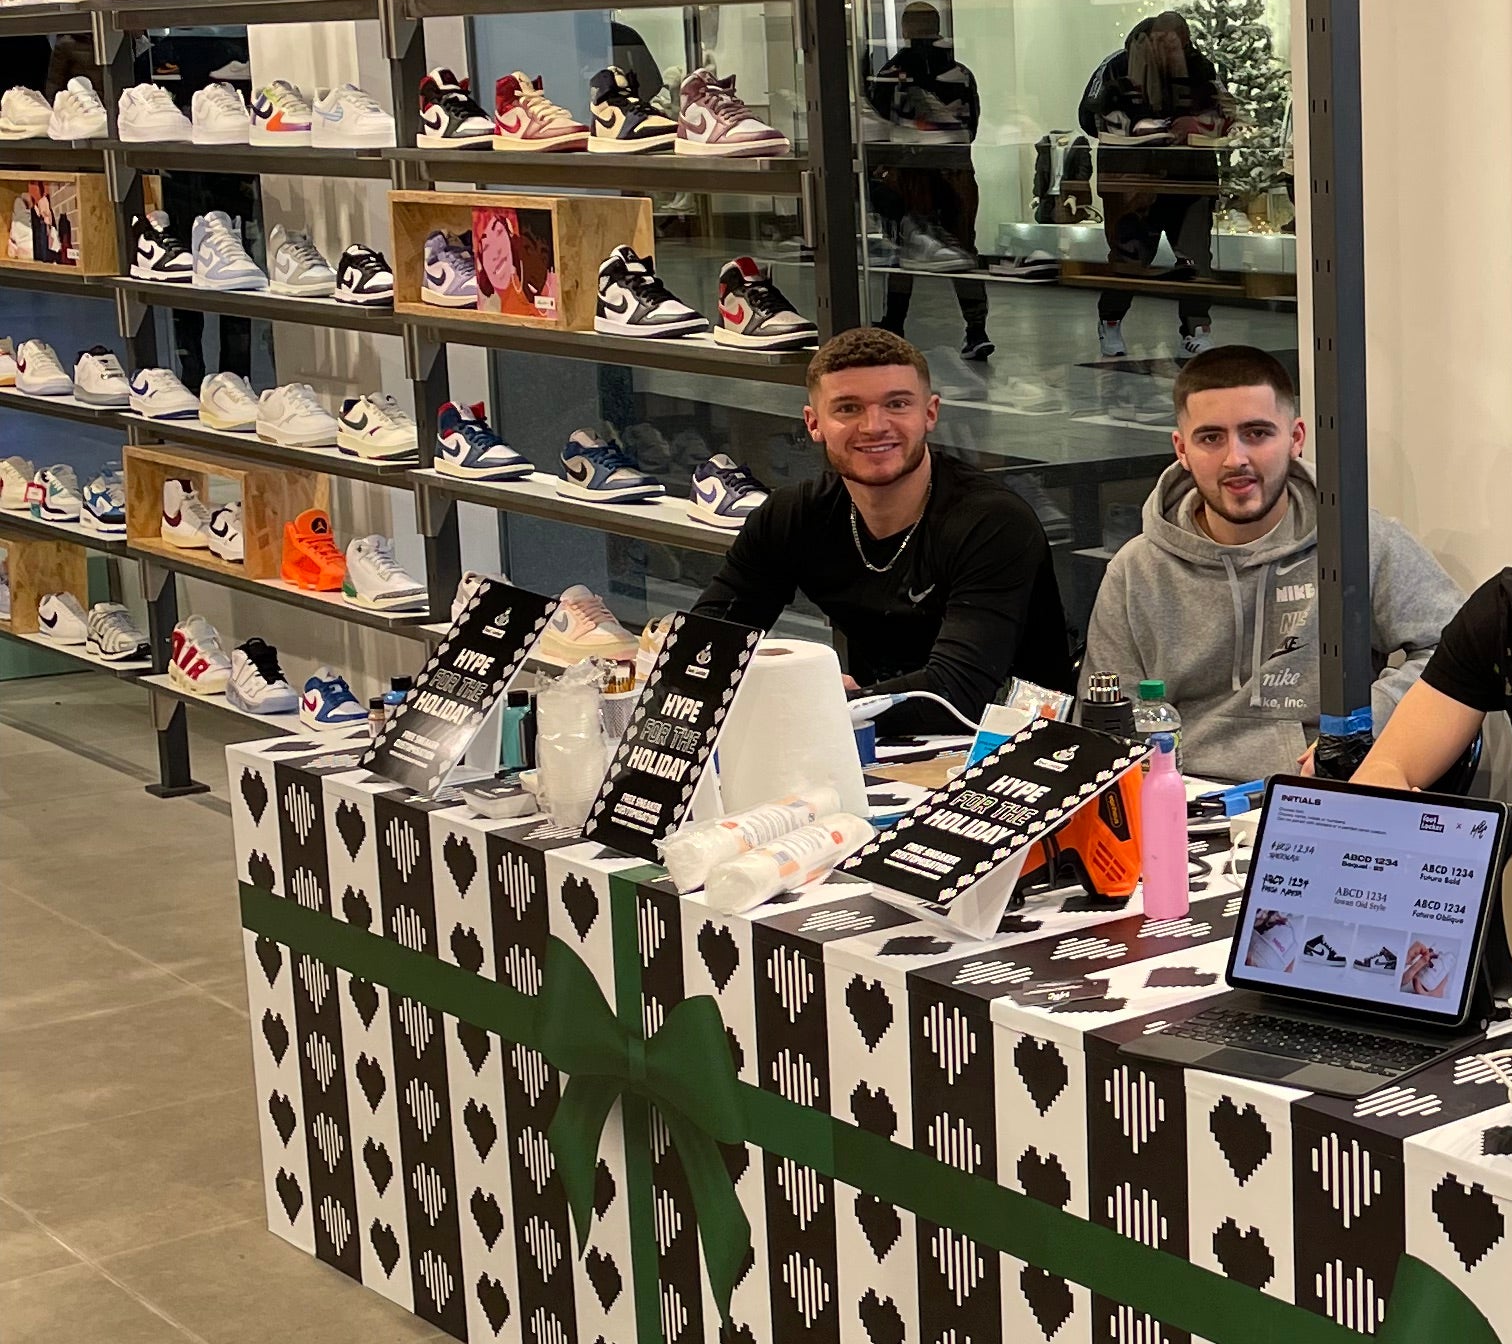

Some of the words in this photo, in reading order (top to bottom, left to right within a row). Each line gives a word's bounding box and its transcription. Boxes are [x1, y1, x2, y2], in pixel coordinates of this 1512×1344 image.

[1275, 583, 1315, 603] NIKE
[453, 648, 496, 676] HYPE
[429, 668, 462, 694] FOR
[456, 676, 488, 703] THE
[1263, 667, 1301, 687] nike
[413, 691, 475, 726] HOLIDAY
[660, 693, 704, 723] HYPE
[1250, 696, 1281, 708] ke,
[1285, 696, 1307, 708] Inc.
[639, 718, 672, 745] FOR
[669, 725, 701, 755] THE
[627, 745, 691, 782] HOLIDAY
[987, 775, 1052, 803] HYPE
[1281, 795, 1321, 806] INITIALS
[949, 789, 999, 815] FOR
[990, 800, 1039, 827] THE
[922, 808, 1016, 845] HOLIDAY
[1343, 853, 1372, 863] ABCD
[1374, 857, 1398, 867] 1234
[1421, 863, 1448, 875] ABCD
[1451, 867, 1474, 879] 1234
[1335, 886, 1364, 899] ABCD
[1366, 890, 1387, 902] 1234
[1413, 899, 1441, 910] ABCD
[1443, 903, 1466, 914] 1234
